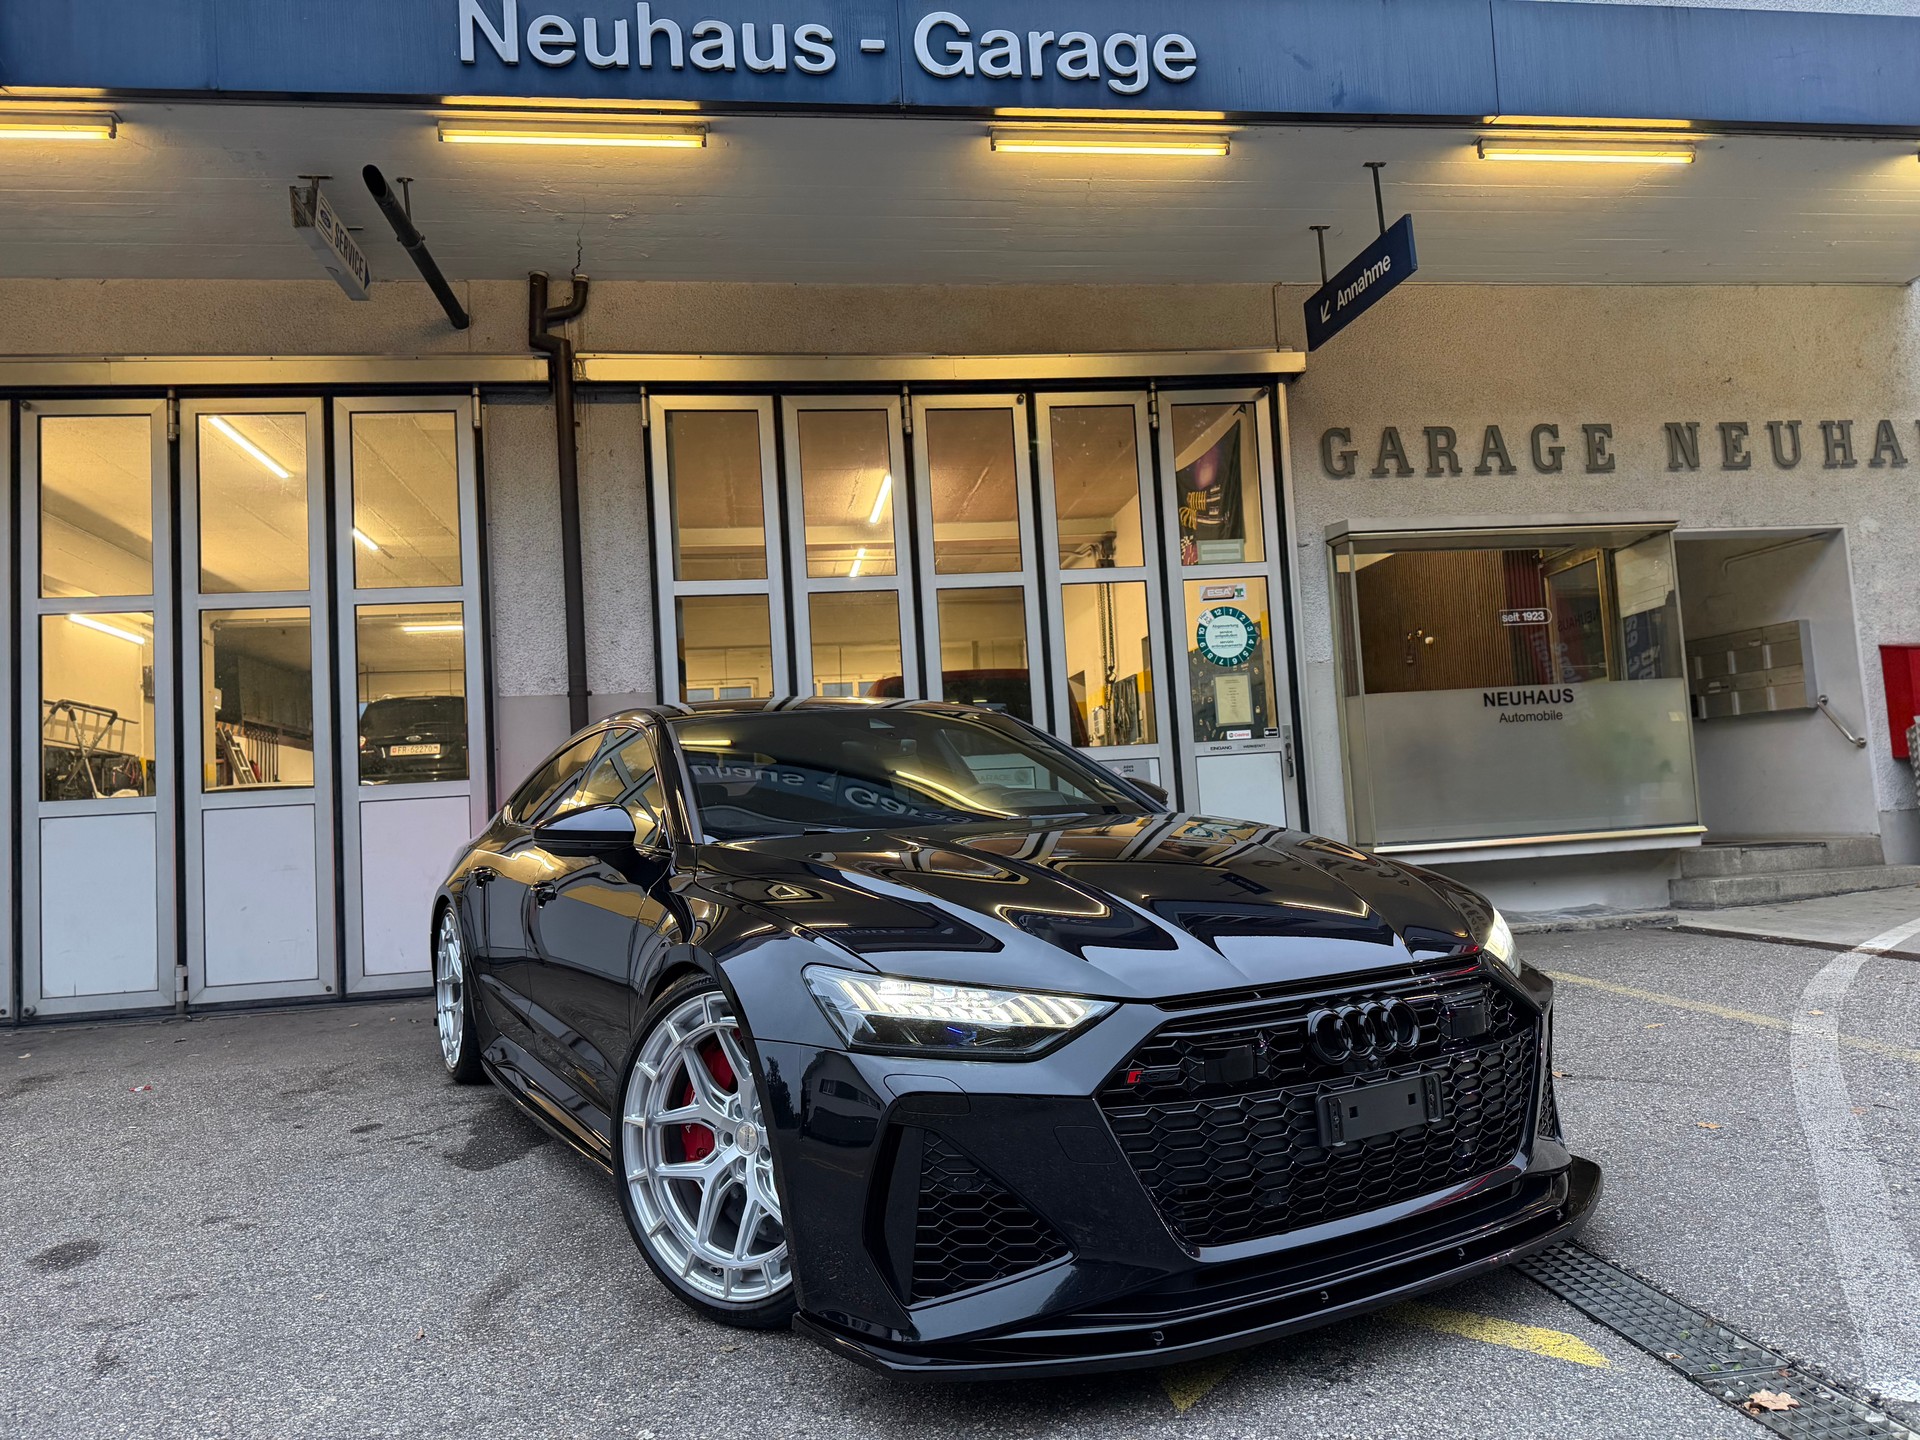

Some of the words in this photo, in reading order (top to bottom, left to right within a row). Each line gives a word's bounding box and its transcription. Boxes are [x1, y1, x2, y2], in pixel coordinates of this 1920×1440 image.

[457, 0, 837, 75] Neuhaus
[913, 11, 1197, 96] Garage
[334, 221, 365, 282] SERVICE
[1336, 255, 1392, 312] Annahme
[1321, 423, 1616, 477] GARAGE
[1664, 419, 1920, 470] NEUHA
[1207, 587, 1231, 597] ESA
[1502, 612, 1520, 623] seit
[1522, 611, 1545, 622] 1923
[1483, 688, 1574, 707] NEUHAUS
[1499, 710, 1563, 724] Automobile
